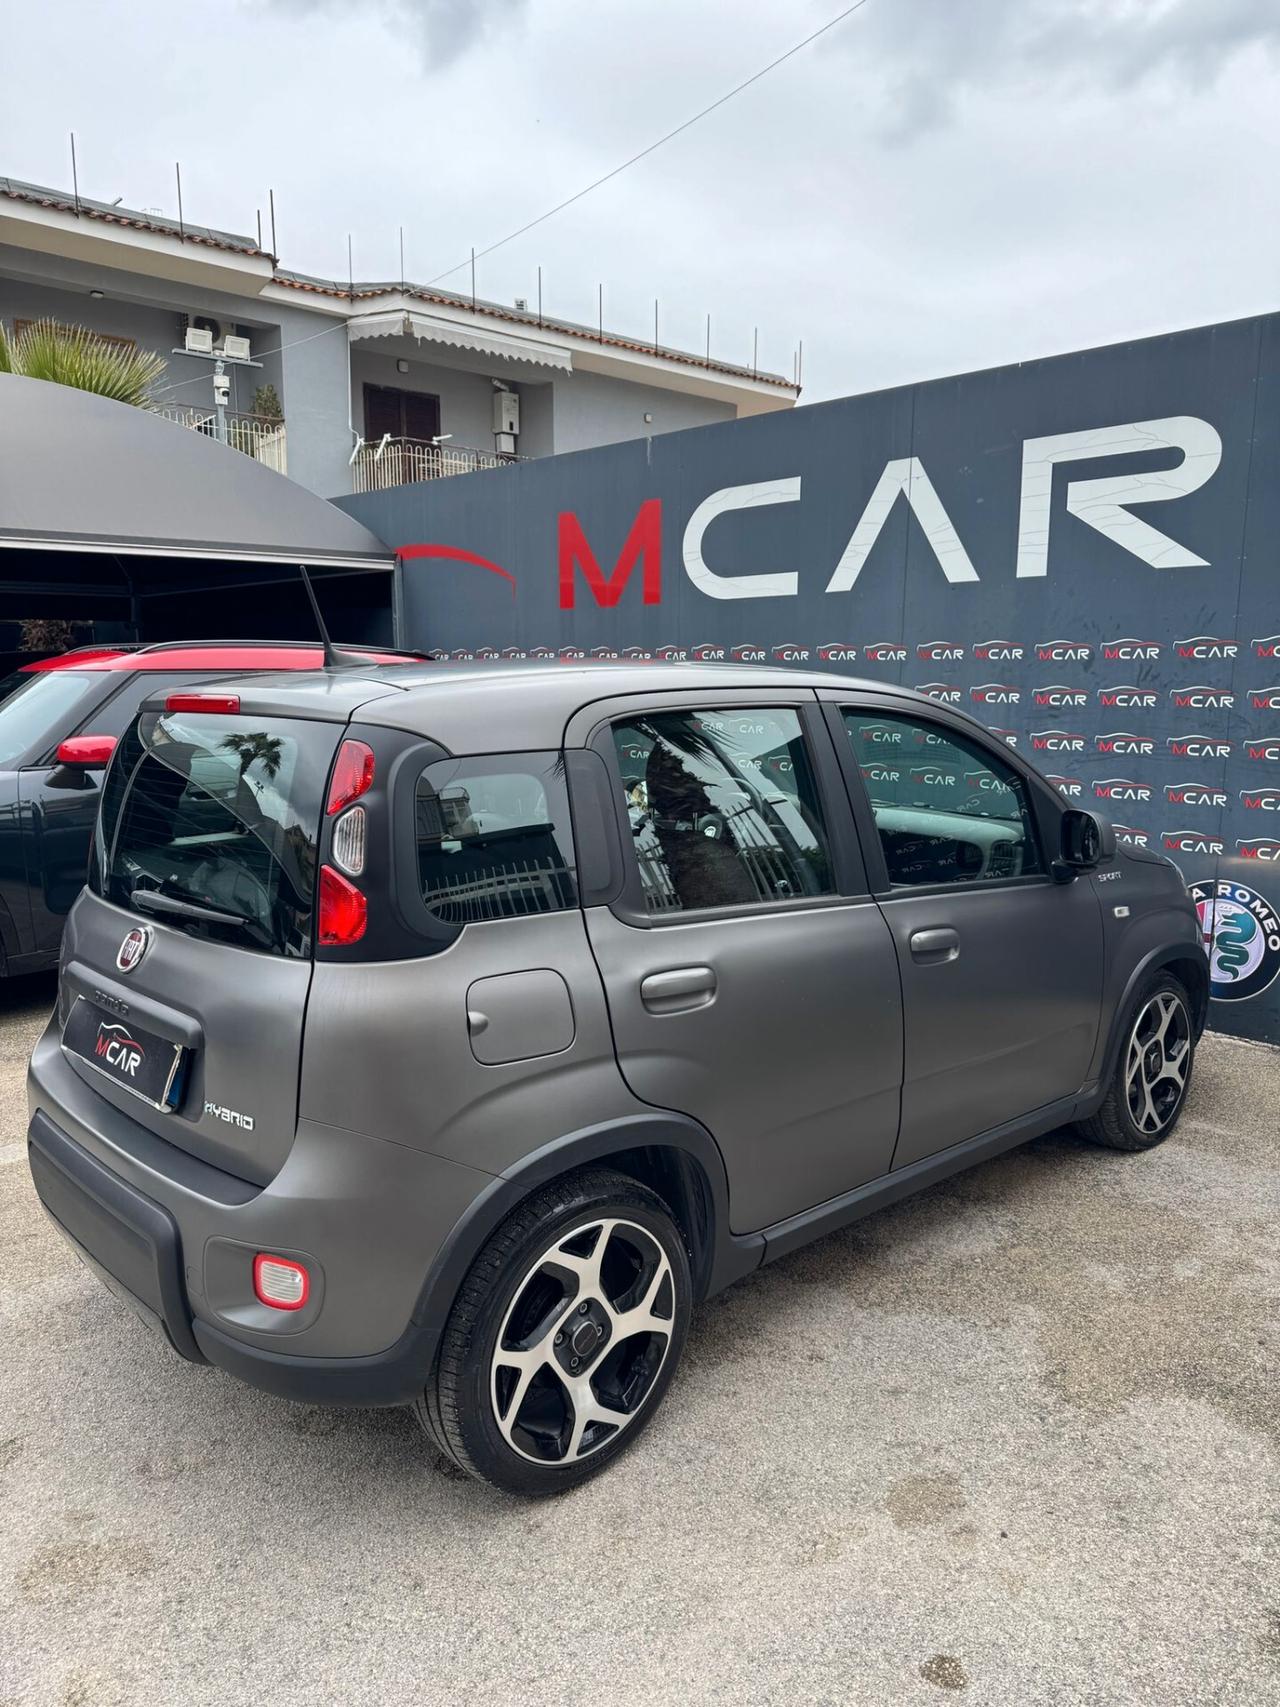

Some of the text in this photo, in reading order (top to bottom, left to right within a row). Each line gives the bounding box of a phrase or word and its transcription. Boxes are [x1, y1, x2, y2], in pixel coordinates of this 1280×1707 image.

[558, 415, 1223, 609] MCAR
[866, 650, 907, 661] MCAR
[918, 649, 964, 660] MCAR
[975, 648, 1024, 661] MCAR
[1039, 648, 1090, 661] MCAR
[1104, 647, 1160, 660] MCAR
[1178, 646, 1238, 658] MCAR
[924, 691, 961, 703] CAR
[972, 691, 1020, 704] MCAR
[1036, 694, 1087, 706] MCAR
[1102, 694, 1157, 707] MCAR
[1175, 695, 1234, 708] MCAR
[1253, 696, 1280, 709] MC
[1033, 738, 1084, 751] MCAR
[1099, 741, 1154, 754] MCAR
[1172, 743, 1231, 757] MCAR
[1249, 746, 1280, 760] MC
[1096, 786, 1150, 801] MCAR
[1168, 791, 1227, 806] MCAR
[1245, 796, 1280, 810] MC
[1164, 838, 1224, 855] MCAR
[1217, 884, 1280, 951] ROMEO
[95, 1033, 141, 1077] MCAR
[204, 1100, 255, 1131] HYBRID
